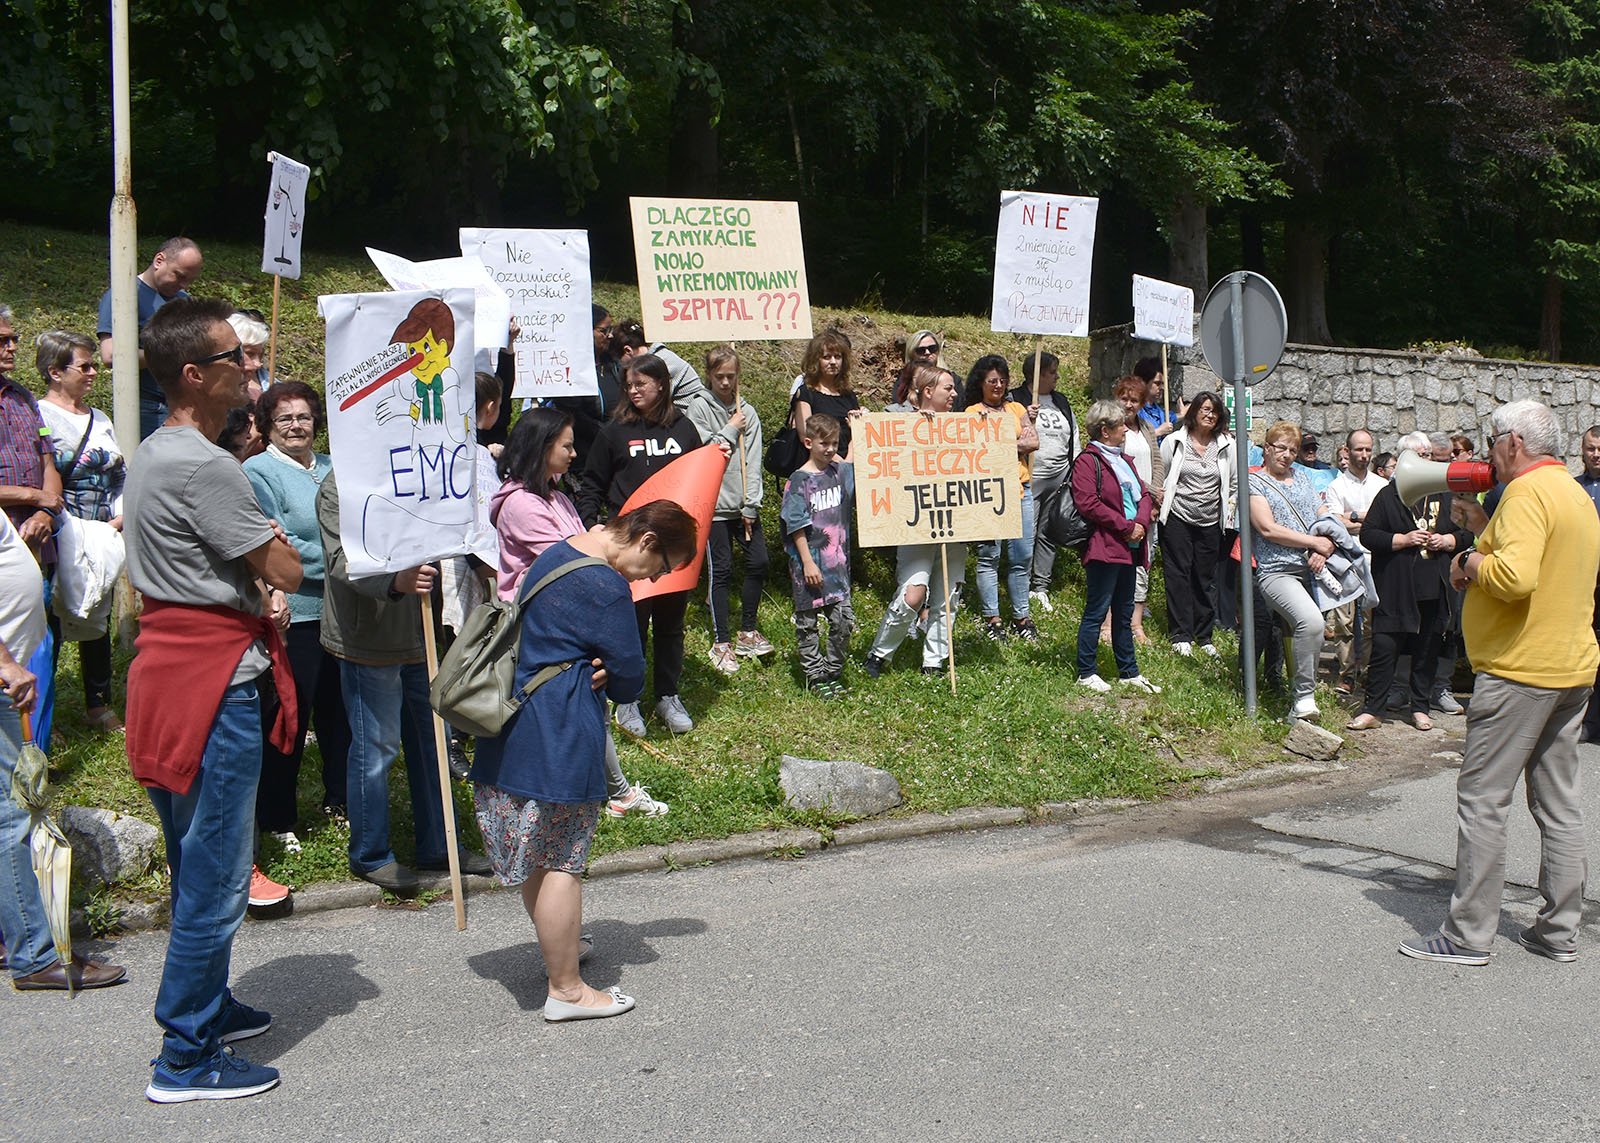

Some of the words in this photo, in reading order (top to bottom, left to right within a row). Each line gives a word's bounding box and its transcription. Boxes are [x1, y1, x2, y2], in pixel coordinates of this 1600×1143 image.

[647, 206, 751, 227] DLACZEGO
[1022, 202, 1069, 230] NIE
[651, 229, 756, 247] ZAMYKACIE
[506, 241, 533, 264] Nie
[654, 251, 704, 271] NOWO
[657, 270, 798, 292] WYREMONTOWANY
[663, 297, 753, 321] SZPITAL
[757, 292, 801, 331] ???
[551, 313, 566, 333] po
[549, 350, 569, 366] AS
[327, 355, 378, 395] ZAPEWNIENIE
[532, 366, 571, 386] WAS!
[1039, 412, 1063, 430] 92
[864, 419, 907, 448] NIE
[912, 417, 1003, 445] CHCEMY
[628, 437, 682, 457] FILA
[389, 441, 472, 503] EMC
[867, 451, 901, 480] SIĘ
[911, 442, 990, 476] LECZYĆ
[871, 487, 892, 517] W
[904, 477, 1006, 527] JELENIEJ
[929, 509, 954, 539] !!!
